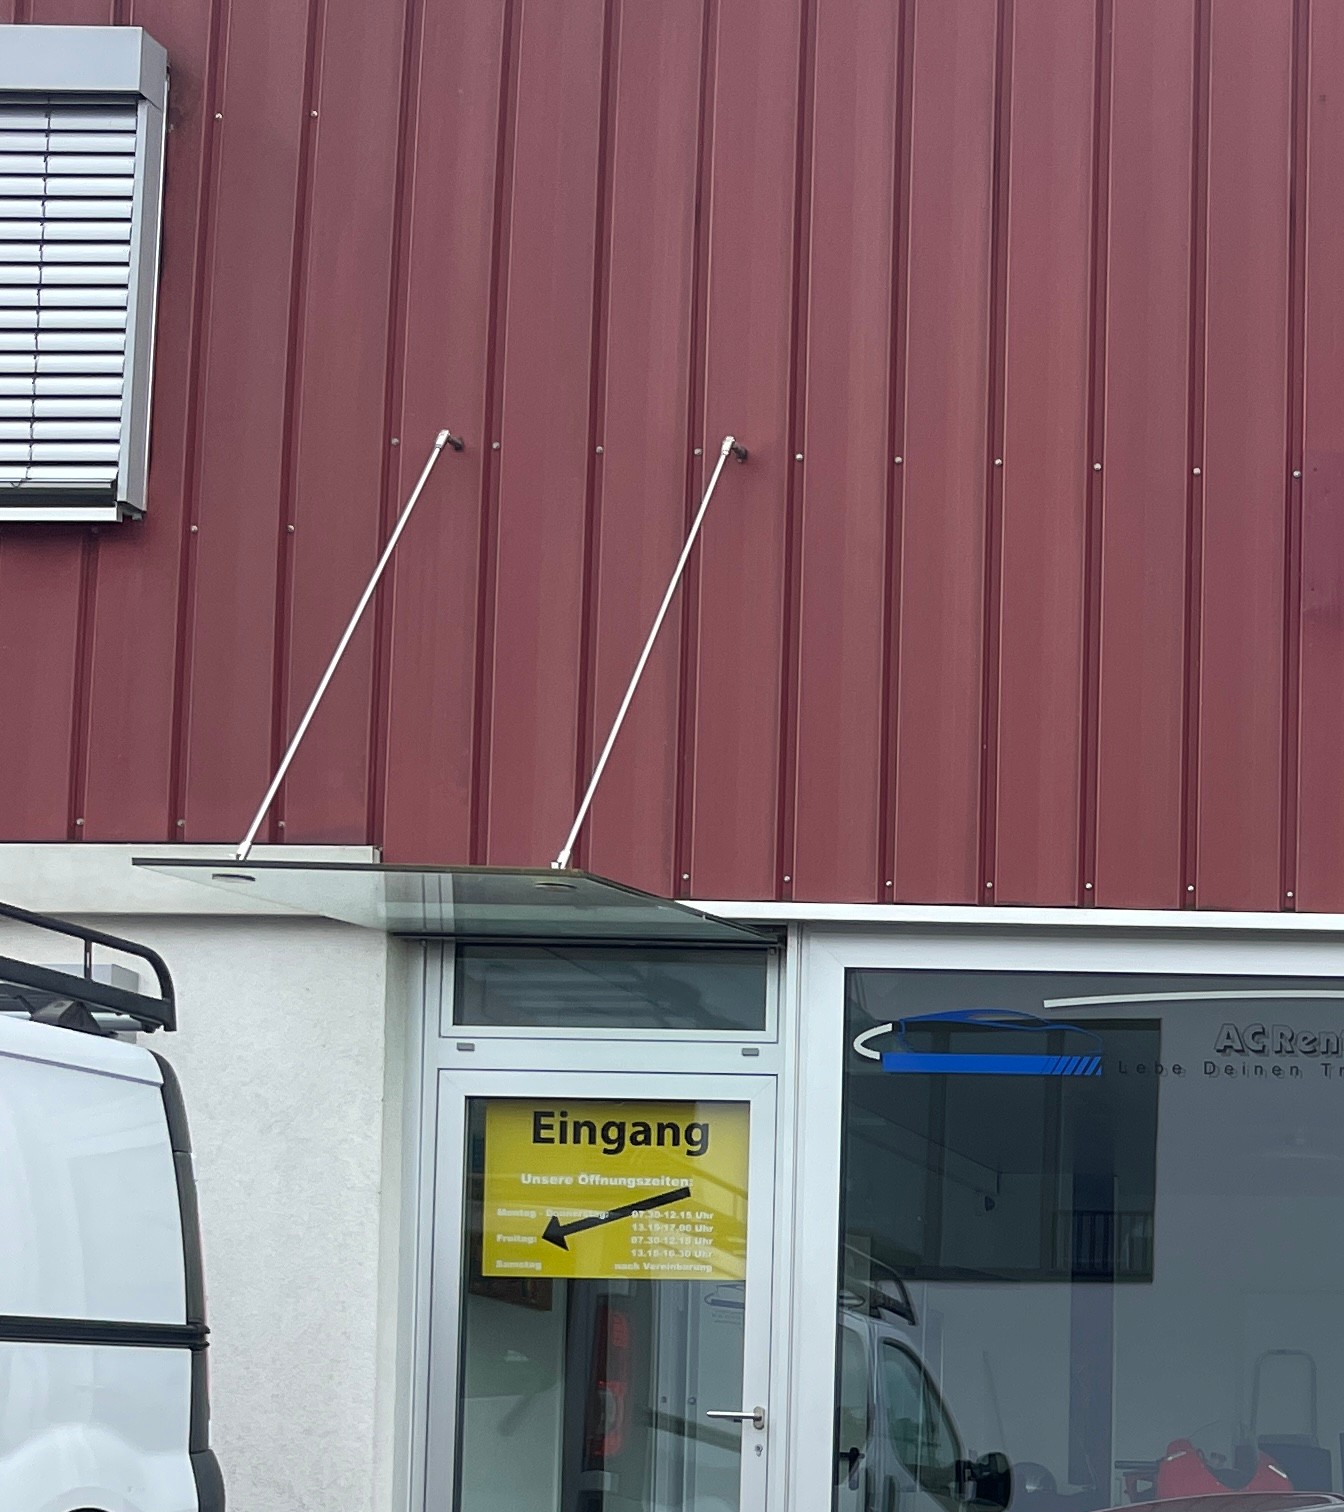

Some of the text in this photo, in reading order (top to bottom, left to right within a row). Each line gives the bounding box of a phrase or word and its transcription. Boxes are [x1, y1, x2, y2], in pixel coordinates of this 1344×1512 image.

[1117, 1060, 1184, 1076] Lebe
[1203, 1060, 1300, 1078] Deinen
[532, 1110, 710, 1156] Eingang
[520, 1173, 694, 1189] Unsere Öffnungszeiten:
[496, 1208, 537, 1219] Montag
[695, 1211, 714, 1220] Uhr
[694, 1224, 714, 1232] Uhr
[694, 1236, 713, 1245] Uhr
[694, 1249, 713, 1258] Uhr
[643, 1262, 713, 1273] Vereinbarung
